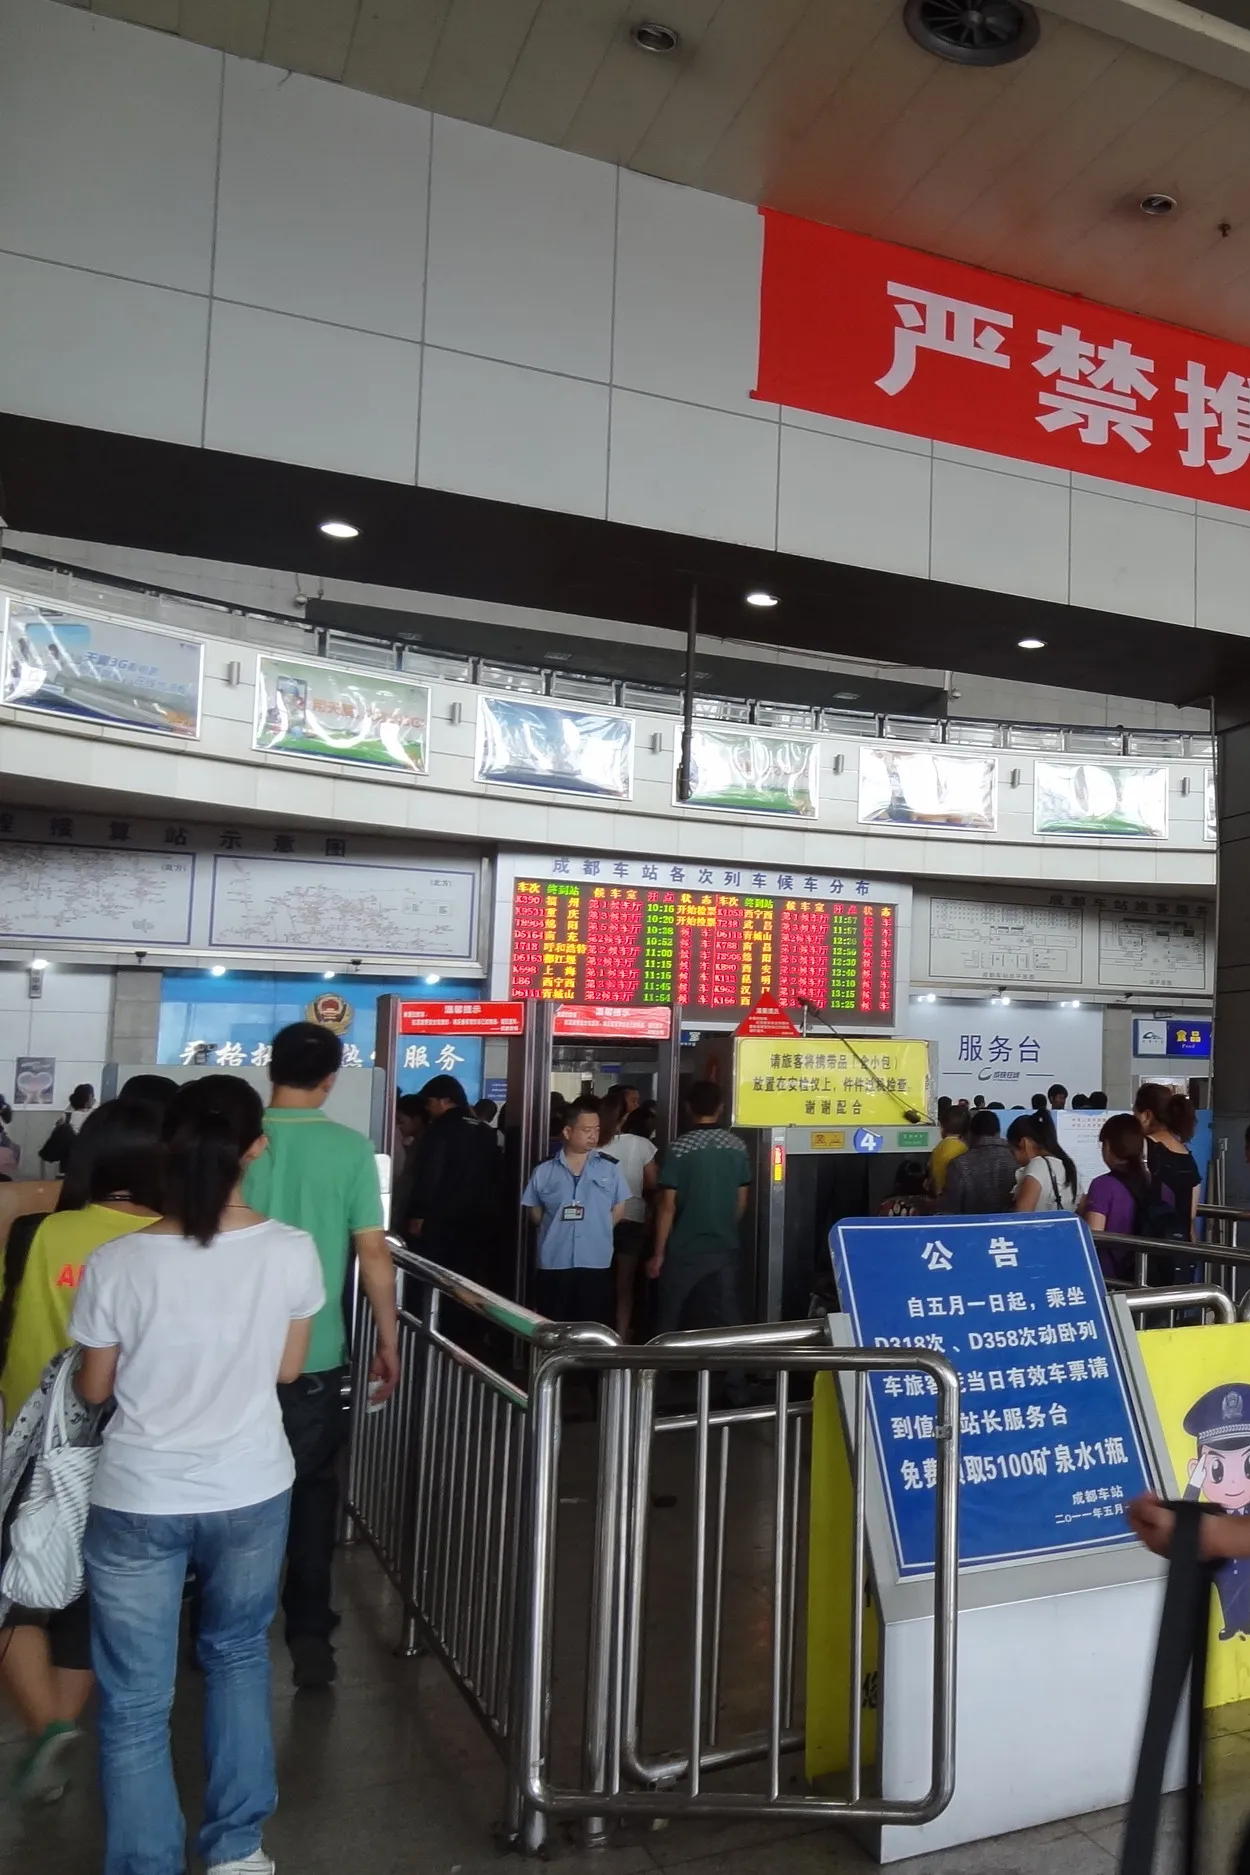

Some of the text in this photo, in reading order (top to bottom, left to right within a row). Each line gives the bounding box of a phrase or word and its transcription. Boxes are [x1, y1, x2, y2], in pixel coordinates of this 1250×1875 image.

[552, 857, 871, 896] 成都车站各次列车候车分布
[518, 882, 712, 904] 车次 终到站 候车室 开点 状态
[515, 895, 541, 904] K390
[647, 904, 675, 913] 10:16
[677, 904, 716, 915] 开始检票
[720, 895, 891, 917] 车次 终到站 候车室 开点 状态
[647, 915, 674, 924] 10:20
[676, 916, 716, 927] 开始检票
[834, 916, 857, 924] 11:57
[646, 926, 674, 935] 10:38
[646, 937, 673, 946] 10:52
[833, 937, 856, 945] 12:20
[645, 948, 673, 957] 11:00
[833, 948, 856, 956] 12:30
[645, 960, 672, 969] 11:15
[832, 969, 856, 977] 12:40
[512, 977, 531, 986] L86
[644, 982, 671, 991] 11:45
[832, 980, 855, 988] 13:10
[643, 993, 671, 1002] 11:54
[831, 990, 855, 998] 13:15
[714, 997, 736, 1005] K166
[831, 1001, 855, 1009] 13:25
[1176, 1029, 1202, 1043] 食品
[958, 1034, 1041, 1063] 服务台
[804, 1100, 863, 1116] 谢谢配合
[860, 1133, 877, 1152] 4
[920, 1236, 1019, 1271] 公告
[907, 1285, 1088, 1319] 自五月一日起，乘坐
[890, 1401, 1068, 1441] 到值站长服务台
[900, 1436, 1129, 1491] 免费取5100矿泉水1瓶
[1071, 1484, 1124, 1505] 成都车站
